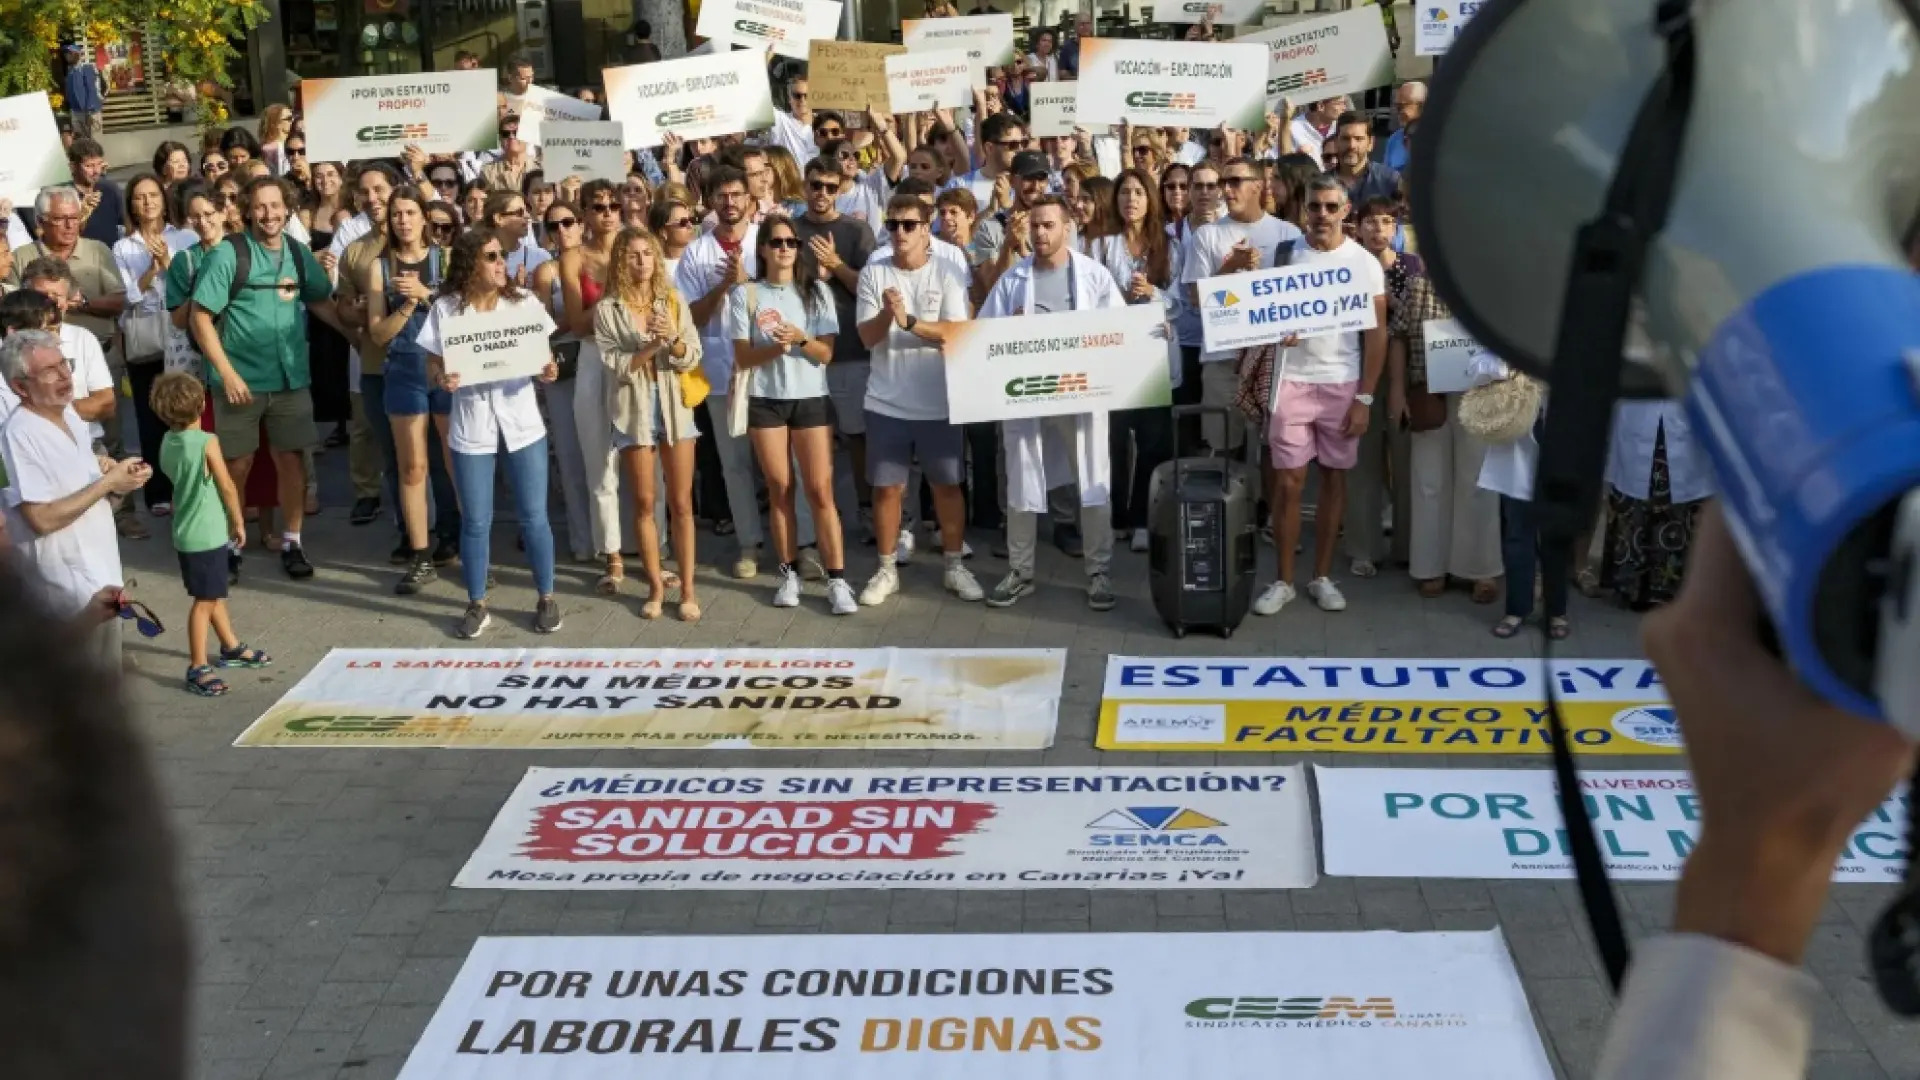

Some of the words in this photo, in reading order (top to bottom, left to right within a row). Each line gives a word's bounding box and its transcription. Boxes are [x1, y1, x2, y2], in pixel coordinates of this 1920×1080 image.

[1289, 25, 1339, 46] ESTATUTO
[397, 83, 451, 97] ESTATUTO
[1252, 267, 1352, 297] ESTATUTO
[1248, 299, 1327, 325] MÉDICO
[1333, 292, 1368, 316] ¡YA!
[445, 330, 502, 347] ¡ESTATUTO
[503, 323, 544, 338] PROPIO
[473, 344, 482, 353] O
[485, 338, 519, 352] NADA!
[1047, 337, 1061, 352] NO
[1005, 372, 1088, 397] CESM
[346, 661, 382, 669] LA
[393, 660, 524, 669] SANIDAD
[673, 660, 714, 668] EN
[722, 660, 856, 669] PELIGRO
[496, 674, 590, 690] SIN
[605, 672, 854, 690] MÉDICOS
[1120, 665, 1527, 688] ESTATUTO
[425, 695, 506, 709] NO
[523, 695, 637, 709] HAY
[653, 694, 902, 709] SANIDAD
[1285, 702, 1503, 723] MÉDICO
[1523, 707, 1553, 723] Y
[284, 715, 473, 732] CESM
[540, 773, 765, 797] ¿MÉDICOS
[779, 778, 853, 794] SIN
[867, 772, 1288, 794] REPRESENTACIÓN?
[1384, 792, 1535, 820] POR
[554, 806, 834, 829] SANIDAD
[849, 806, 955, 829] SIN
[570, 827, 914, 856] SOLUCIÓN
[1089, 834, 1228, 846] SEMCA
[487, 869, 575, 882] Mesa
[582, 869, 691, 885] propia
[701, 869, 742, 881] de
[750, 867, 955, 884] negociación
[965, 870, 1007, 881] en
[1018, 868, 1168, 881] Canarias
[1178, 868, 1245, 883] ¡Ya!
[485, 970, 592, 998] POR
[606, 969, 749, 997] UNAS
[762, 967, 1114, 997] CONDICIONES
[1184, 996, 1397, 1019] CESM
[456, 1017, 840, 1055] LABORALES
[860, 1015, 1103, 1052] DIGNAS
[1184, 1020, 1288, 1028] SINDICATO
